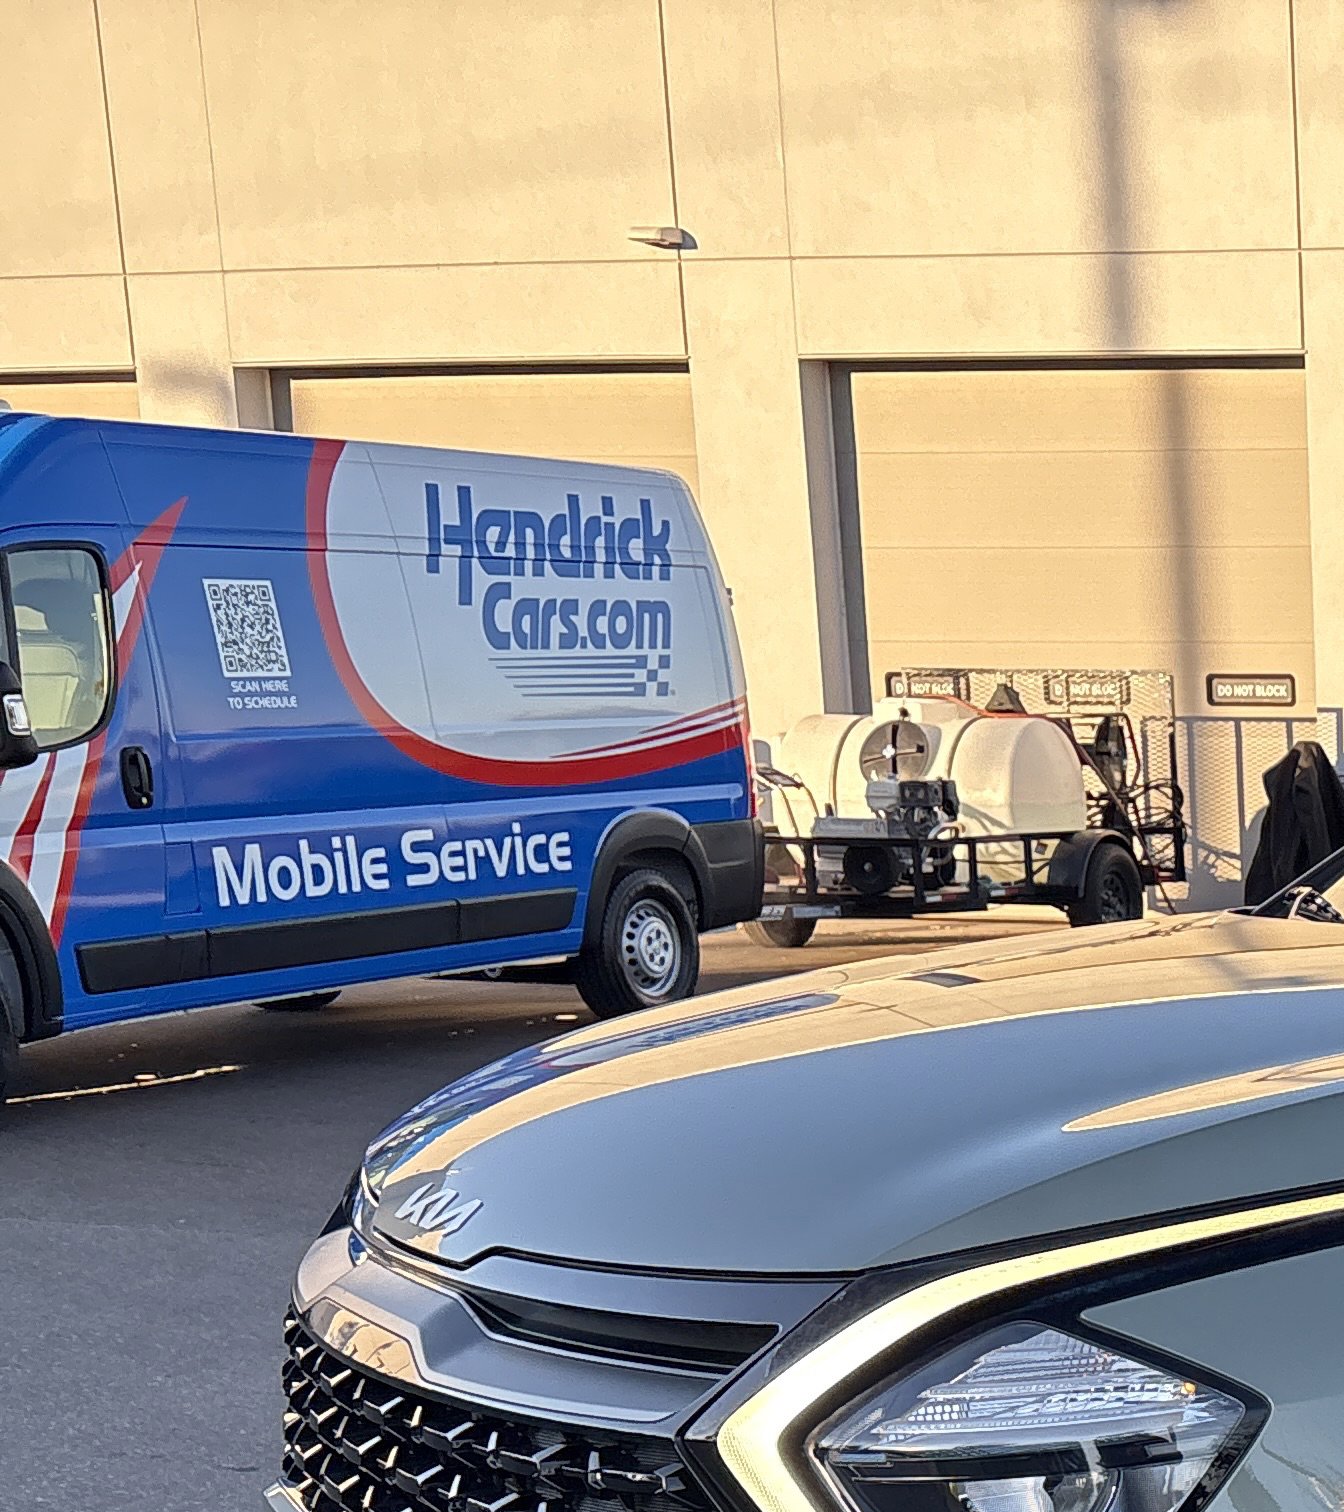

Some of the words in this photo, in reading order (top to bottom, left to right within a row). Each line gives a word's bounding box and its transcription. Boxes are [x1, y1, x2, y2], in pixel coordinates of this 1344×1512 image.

[425, 483, 672, 606] Hendrick
[482, 582, 672, 651] Cars.com
[230, 680, 260, 693] SCAN
[261, 680, 289, 692] HERE
[931, 682, 955, 695] BLOC
[1092, 682, 1120, 696] BLOC
[1217, 684, 1233, 697] DO
[1233, 684, 1254, 697] NOT
[1255, 684, 1288, 697] BLOCK
[227, 697, 243, 709] TO
[244, 696, 298, 708] SCHEDULE
[212, 832, 390, 906] Mobile
[401, 821, 573, 888] Service
[394, 1182, 484, 1237] KIA
